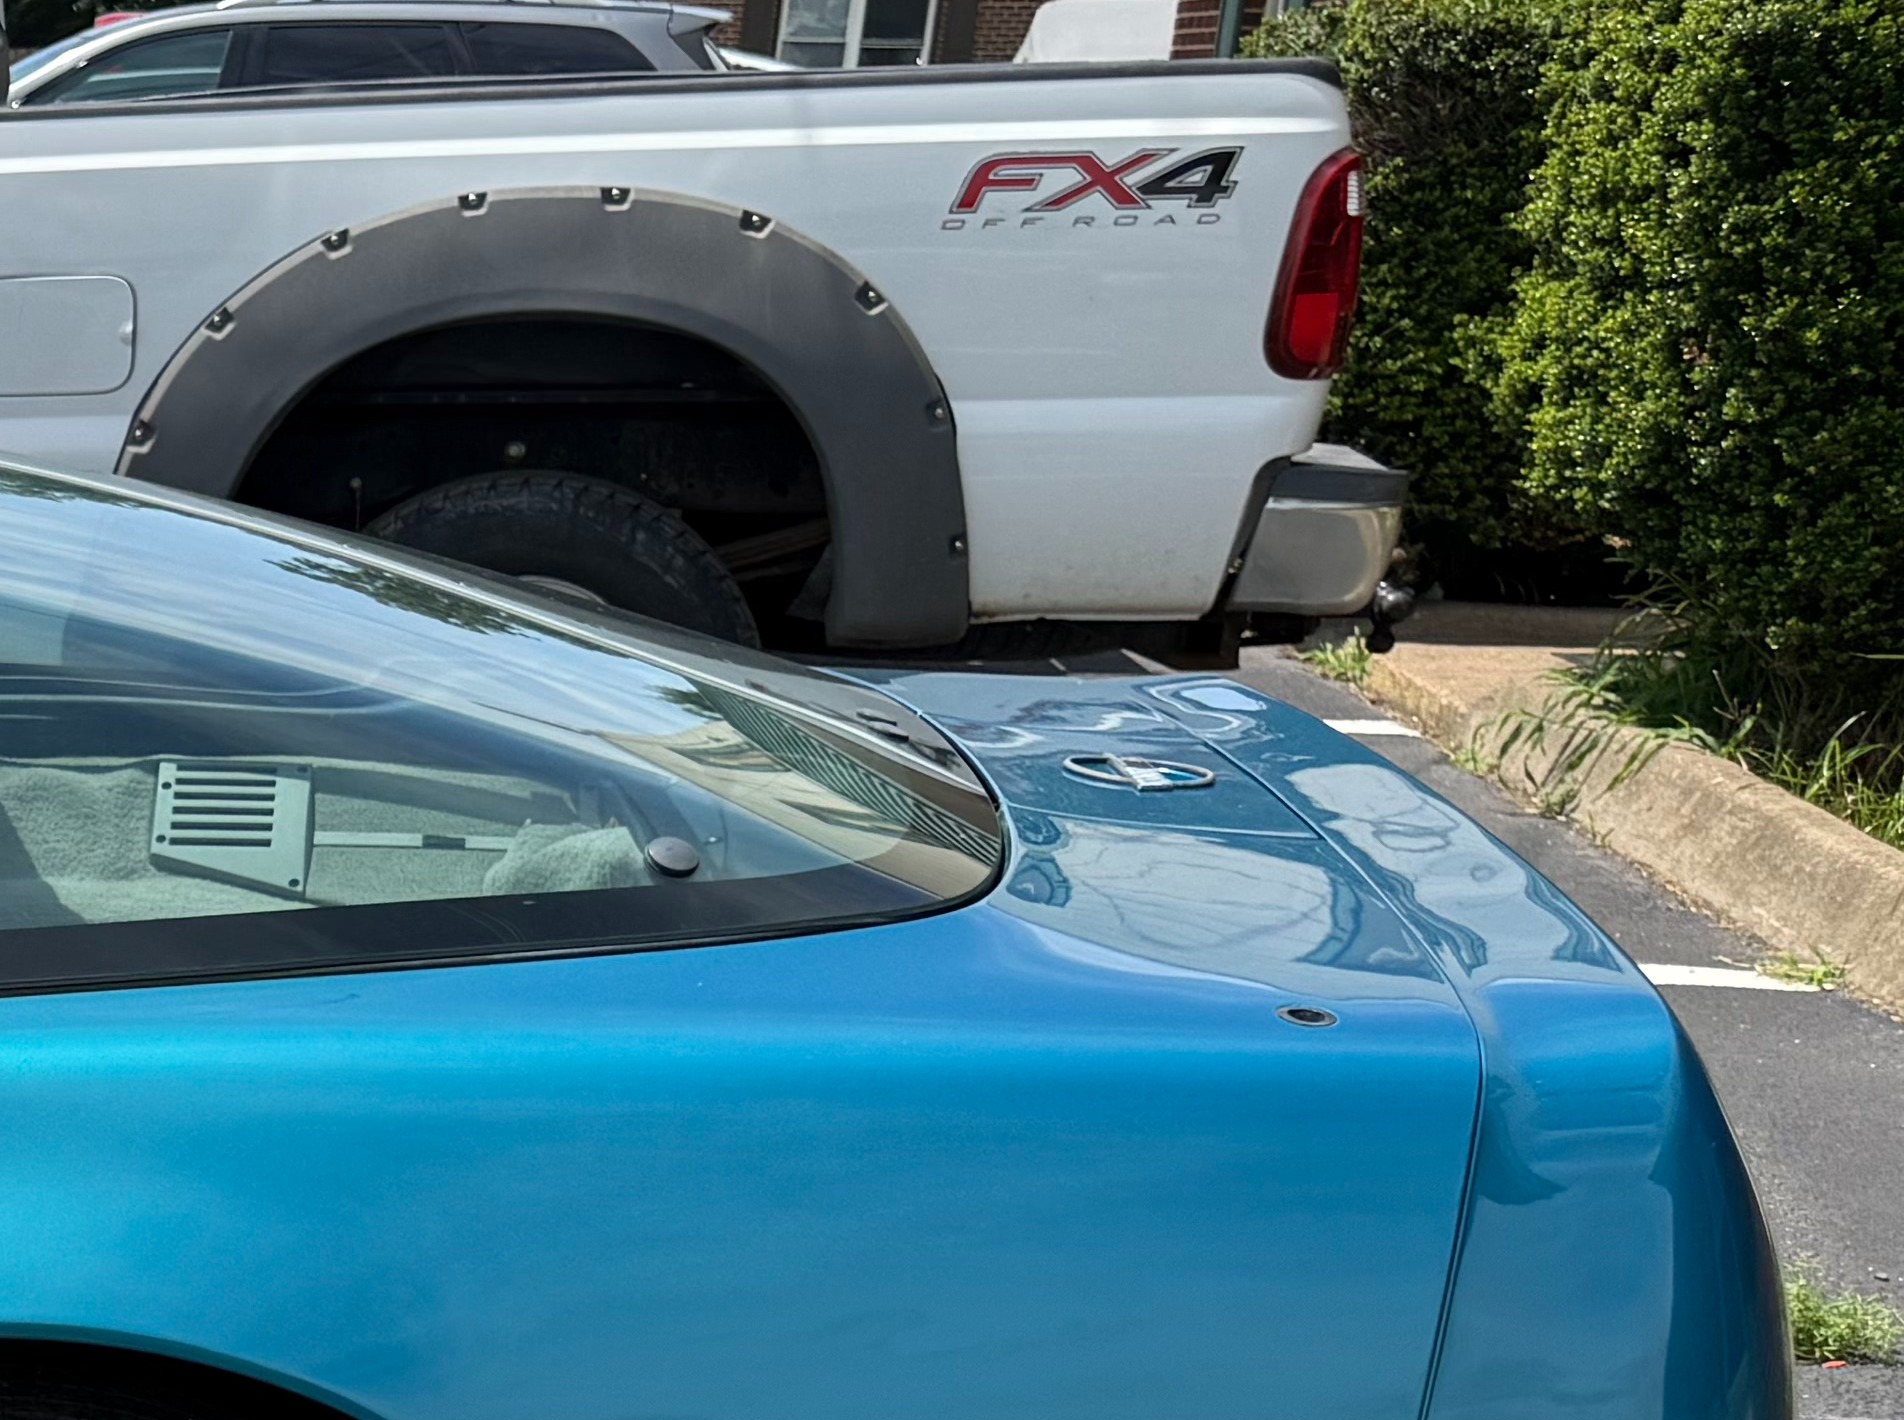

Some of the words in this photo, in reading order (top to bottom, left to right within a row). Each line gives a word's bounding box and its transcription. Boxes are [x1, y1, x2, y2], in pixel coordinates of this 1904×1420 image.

[949, 146, 1244, 214] FX4
[941, 217, 1045, 231] OFF
[1072, 213, 1222, 229] ROAD
